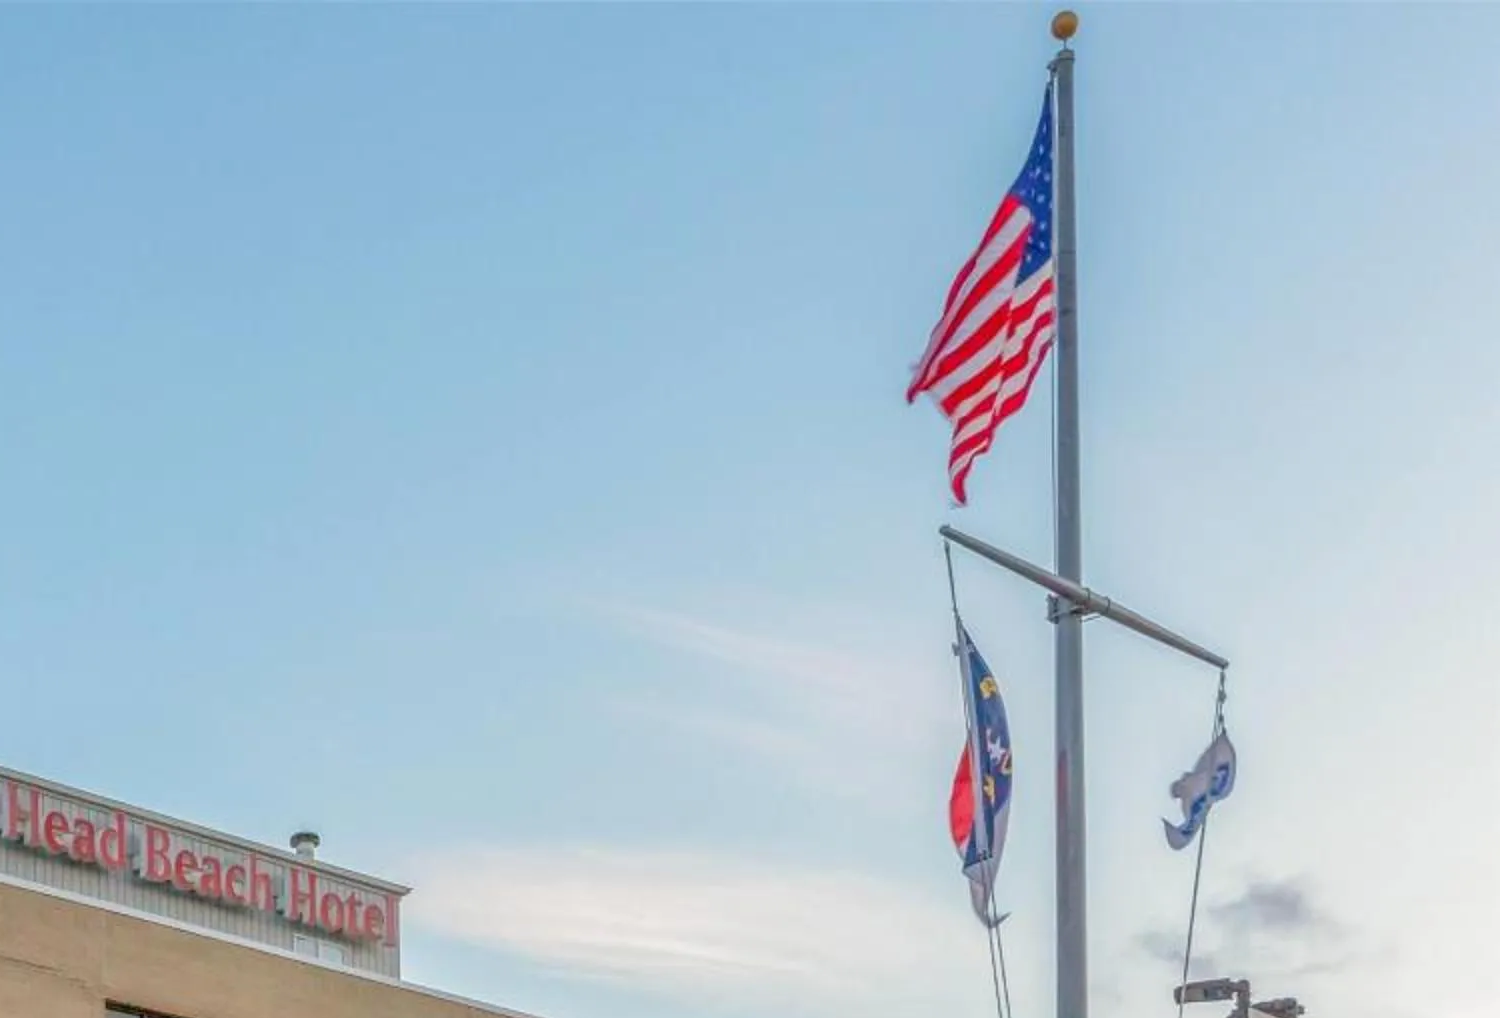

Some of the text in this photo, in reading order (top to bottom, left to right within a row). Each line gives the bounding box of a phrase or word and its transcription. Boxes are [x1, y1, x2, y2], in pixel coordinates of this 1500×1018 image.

[1, 780, 127, 869] Head
[141, 821, 276, 911] Beach
[286, 867, 399, 947] Hotel
